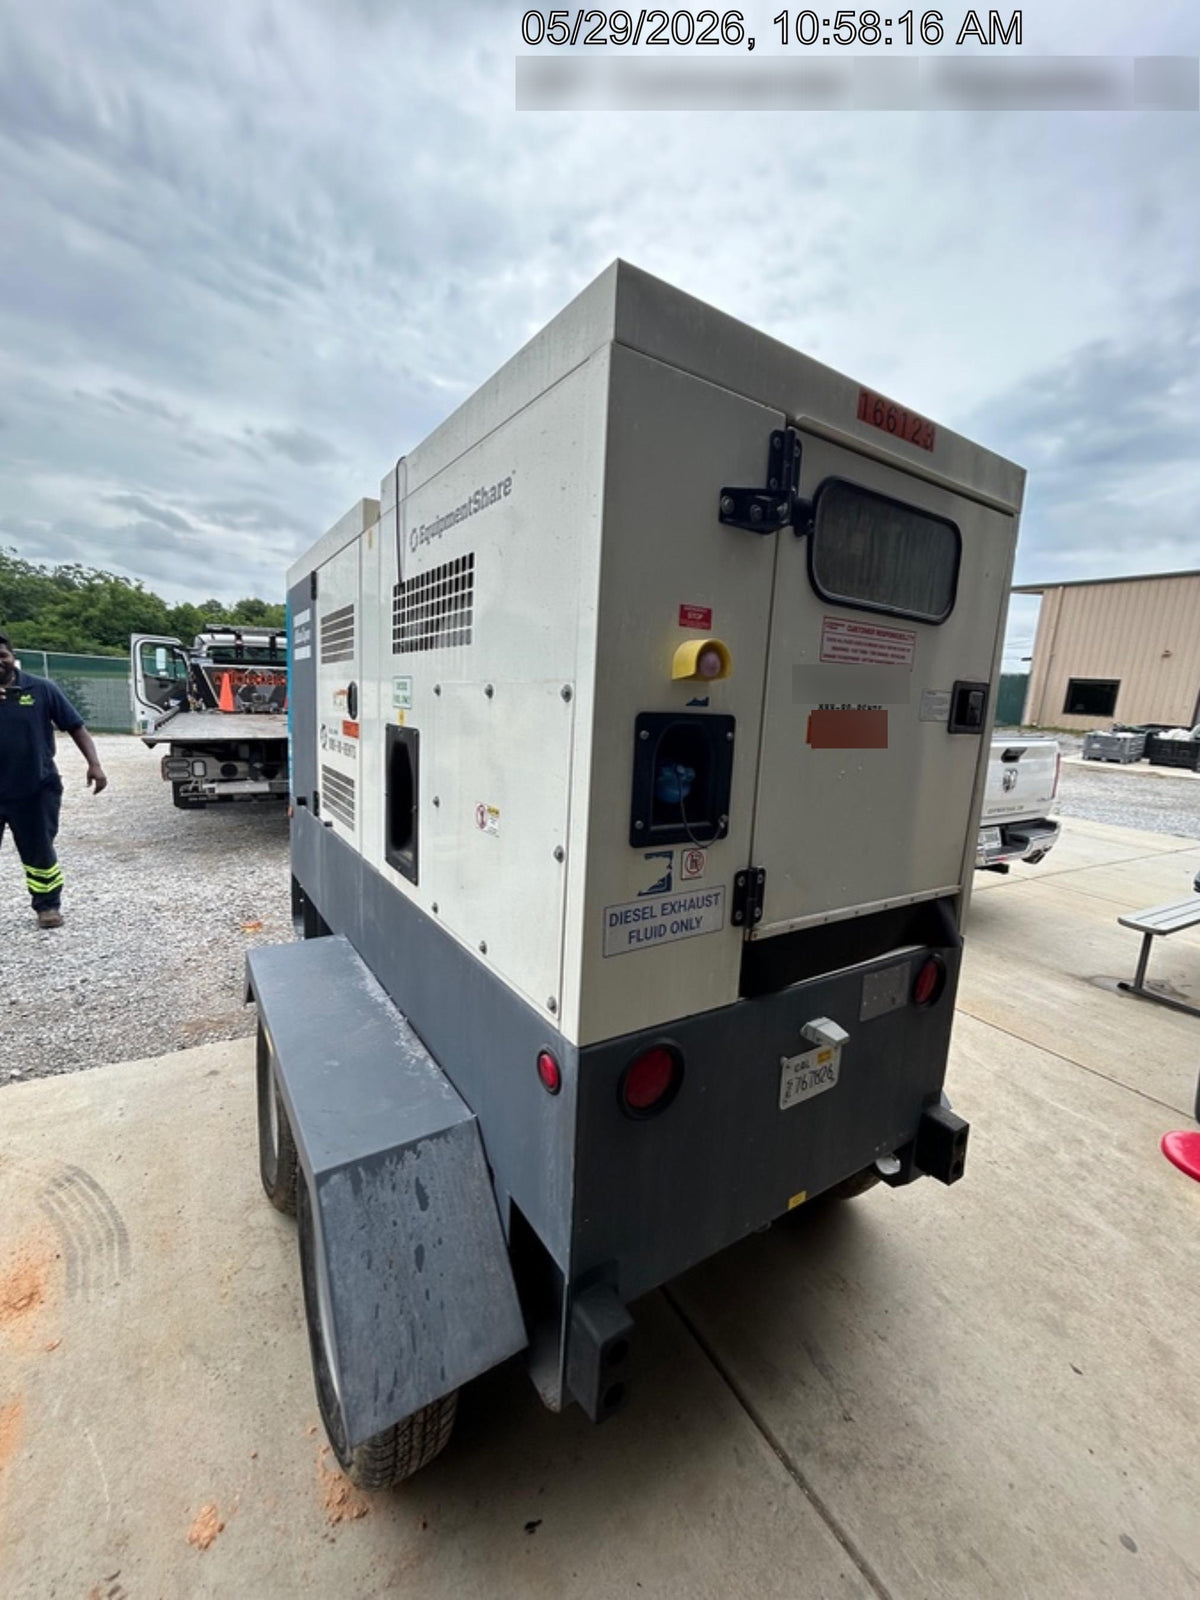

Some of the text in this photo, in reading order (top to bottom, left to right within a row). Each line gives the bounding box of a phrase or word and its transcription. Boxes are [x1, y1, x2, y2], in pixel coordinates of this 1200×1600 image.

[419, 476, 512, 545] EquipmentShare
[609, 892, 720, 927] DIESEL EXHAUST
[628, 916, 704, 945] FLUID ONLY
